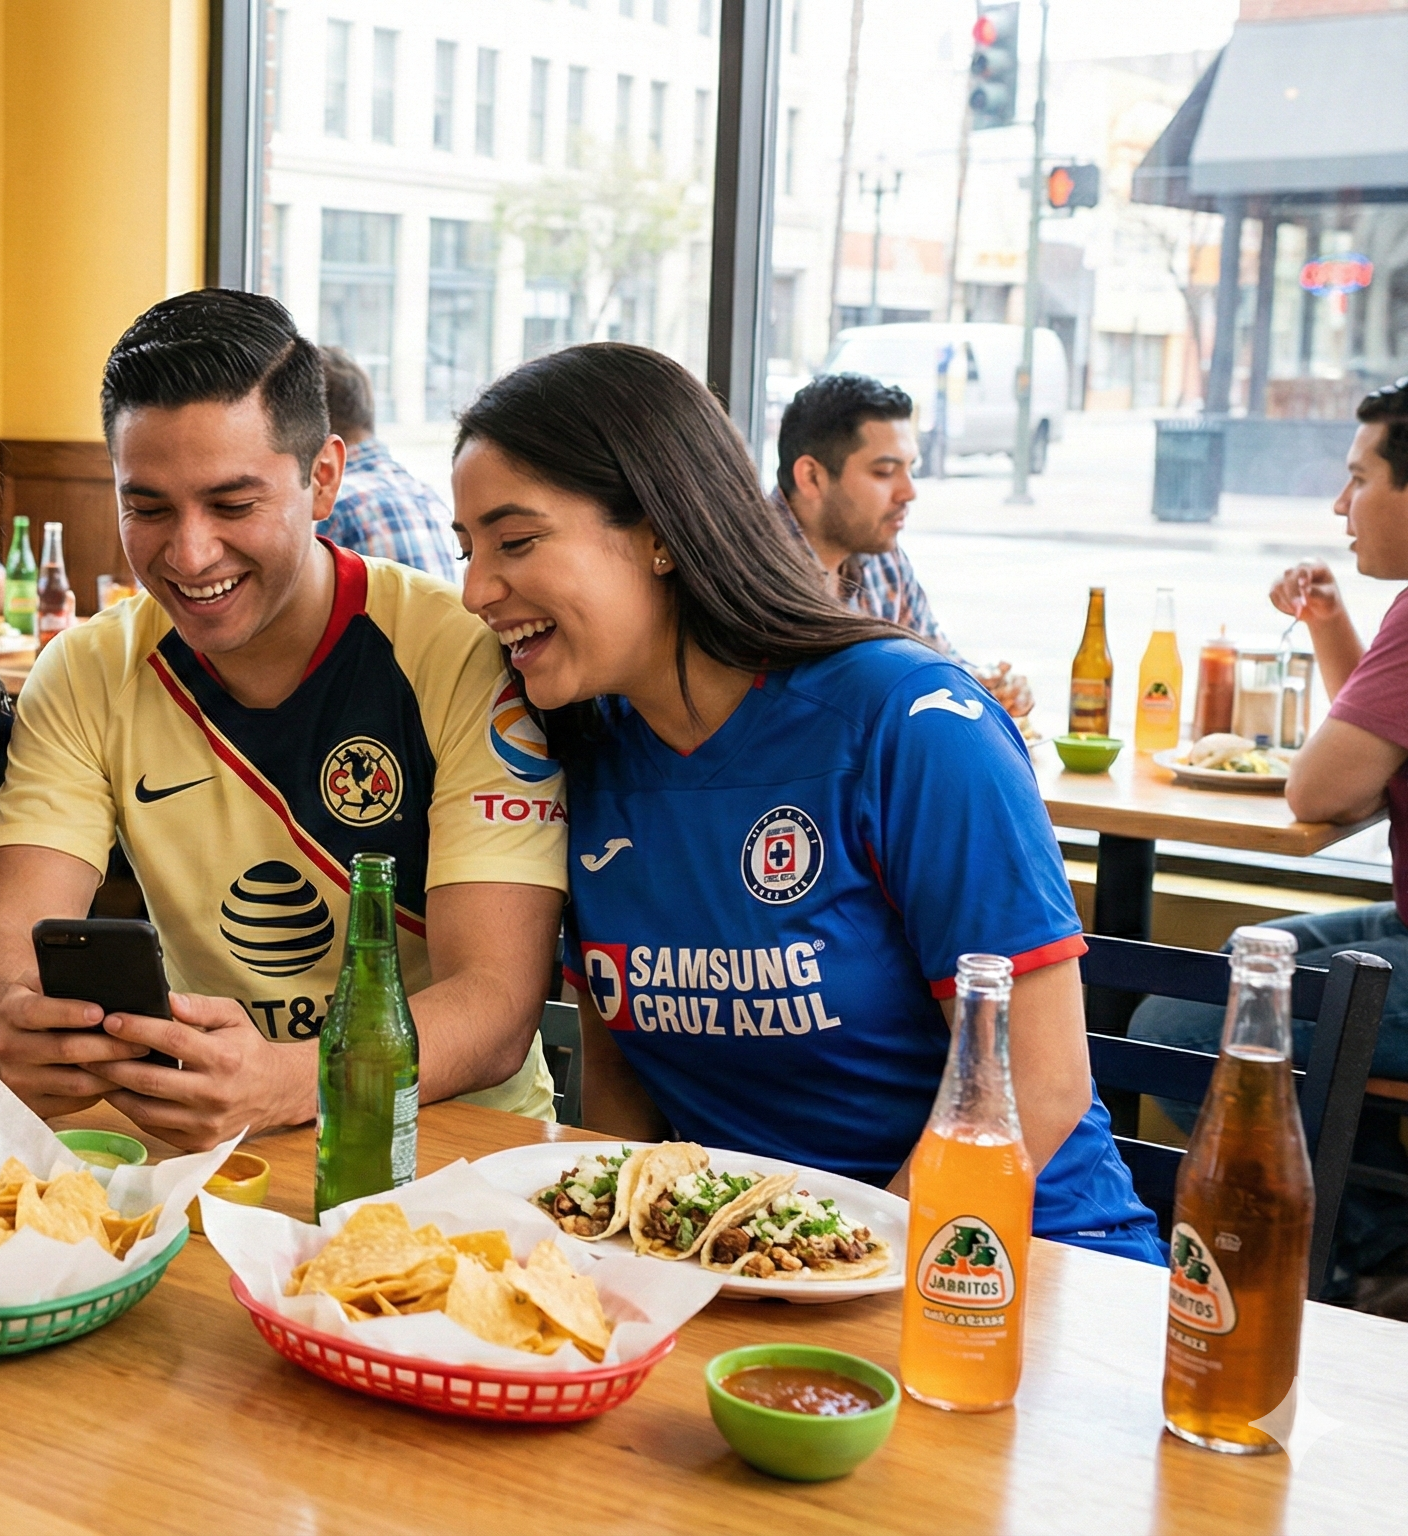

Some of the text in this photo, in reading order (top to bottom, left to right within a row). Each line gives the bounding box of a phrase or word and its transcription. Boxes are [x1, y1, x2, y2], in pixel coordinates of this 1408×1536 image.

[328, 767, 394, 796] C A
[629, 941, 823, 992] SAMSUNG
[234, 994, 336, 1040] T&
[633, 992, 842, 1037] CRUZ AZUL
